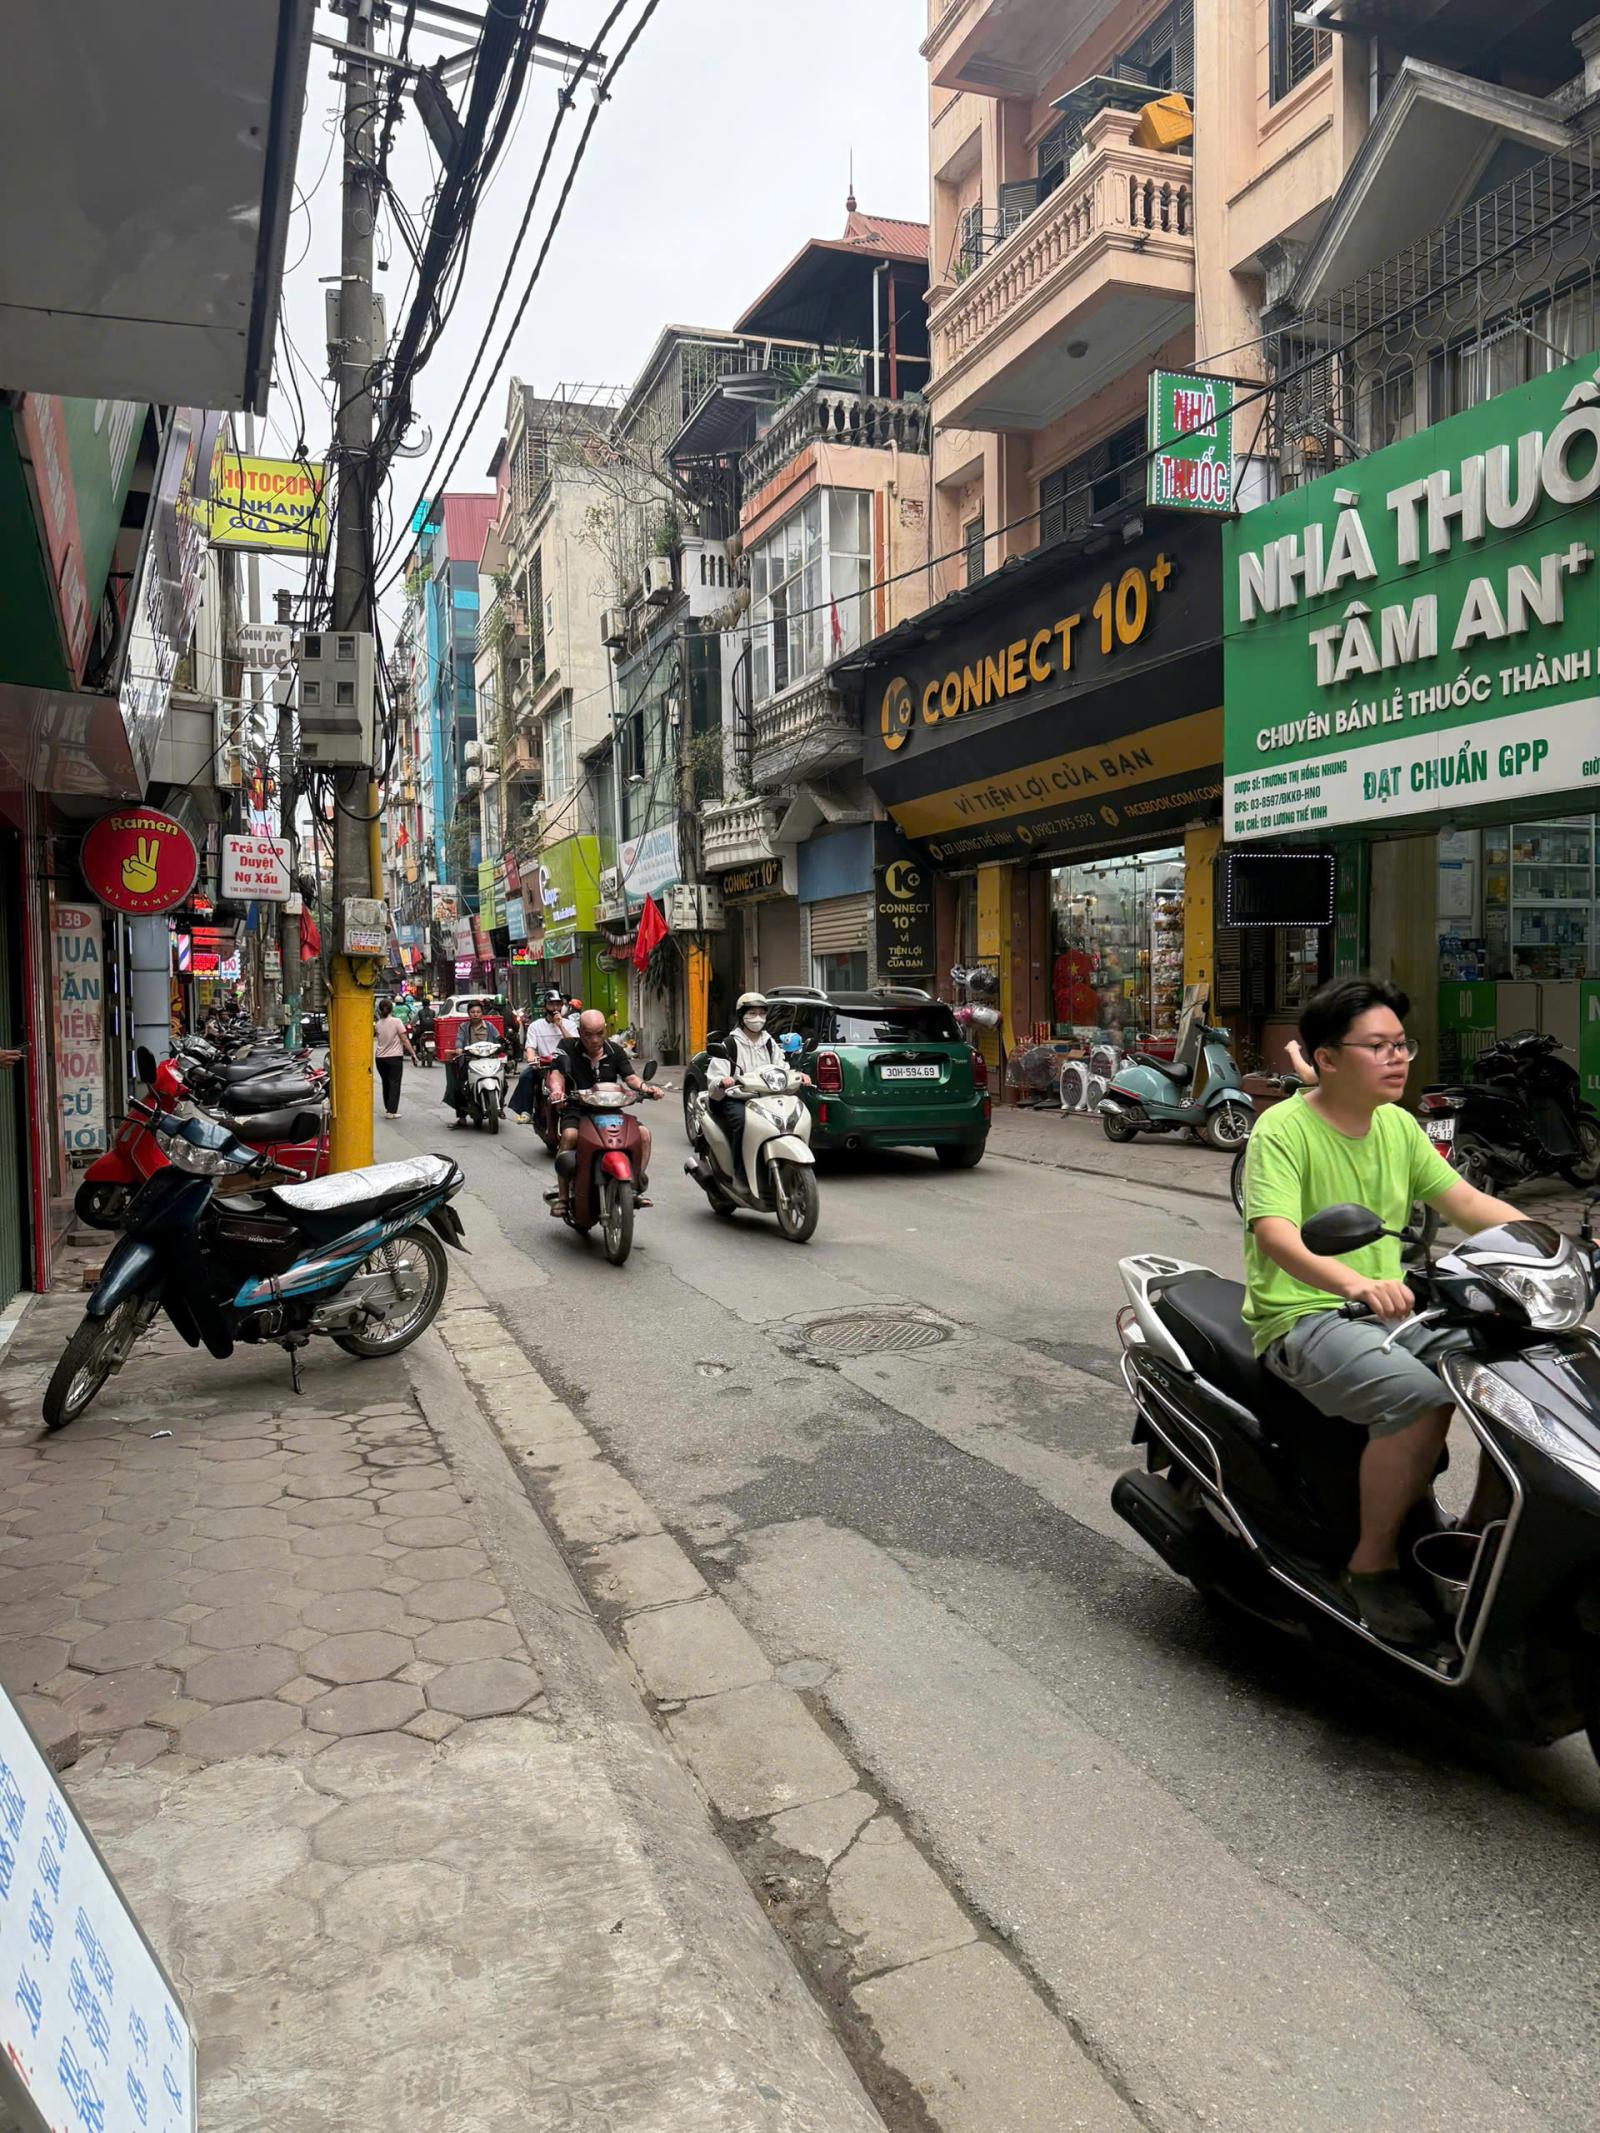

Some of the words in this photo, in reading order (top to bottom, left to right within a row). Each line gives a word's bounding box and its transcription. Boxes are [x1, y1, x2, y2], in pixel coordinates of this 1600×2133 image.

[1173, 384, 1217, 437] NHÀ
[1160, 446, 1227, 504] THUỐC
[1238, 488, 1377, 622] NHÀ
[1309, 600, 1438, 686] TÂM
[922, 613, 1081, 724] CONNECT
[1256, 710, 1330, 752] CHUYÊN
[1335, 699, 1377, 734] BÁN
[1382, 687, 1404, 723] LẺ
[1408, 665, 1492, 717] THUỐC
[1499, 650, 1591, 696] THÀNH
[973, 785, 1014, 812] TIỆN
[1016, 776, 1052, 801] LỢI
[1051, 762, 1098, 788] CỦA
[1099, 748, 1153, 776] BẠN
[1321, 760, 1348, 777] NHUNG
[1363, 766, 1402, 803] ĐẠT
[1410, 740, 1488, 792] CHUẨN
[1499, 738, 1550, 778] GPP
[111, 817, 178, 835] Ramen
[1296, 805, 1309, 821] THẾ
[1310, 805, 1328, 819] VINH
[230, 841, 253, 853] Trả
[240, 856, 273, 870] Duyệt
[235, 872, 251, 885] Nợ
[255, 871, 278, 884] Xấu
[58, 912, 82, 927] 138
[879, 904, 930, 913] CONNECT
[57, 936, 98, 962] UA
[63, 1087, 92, 1115] CŨ
